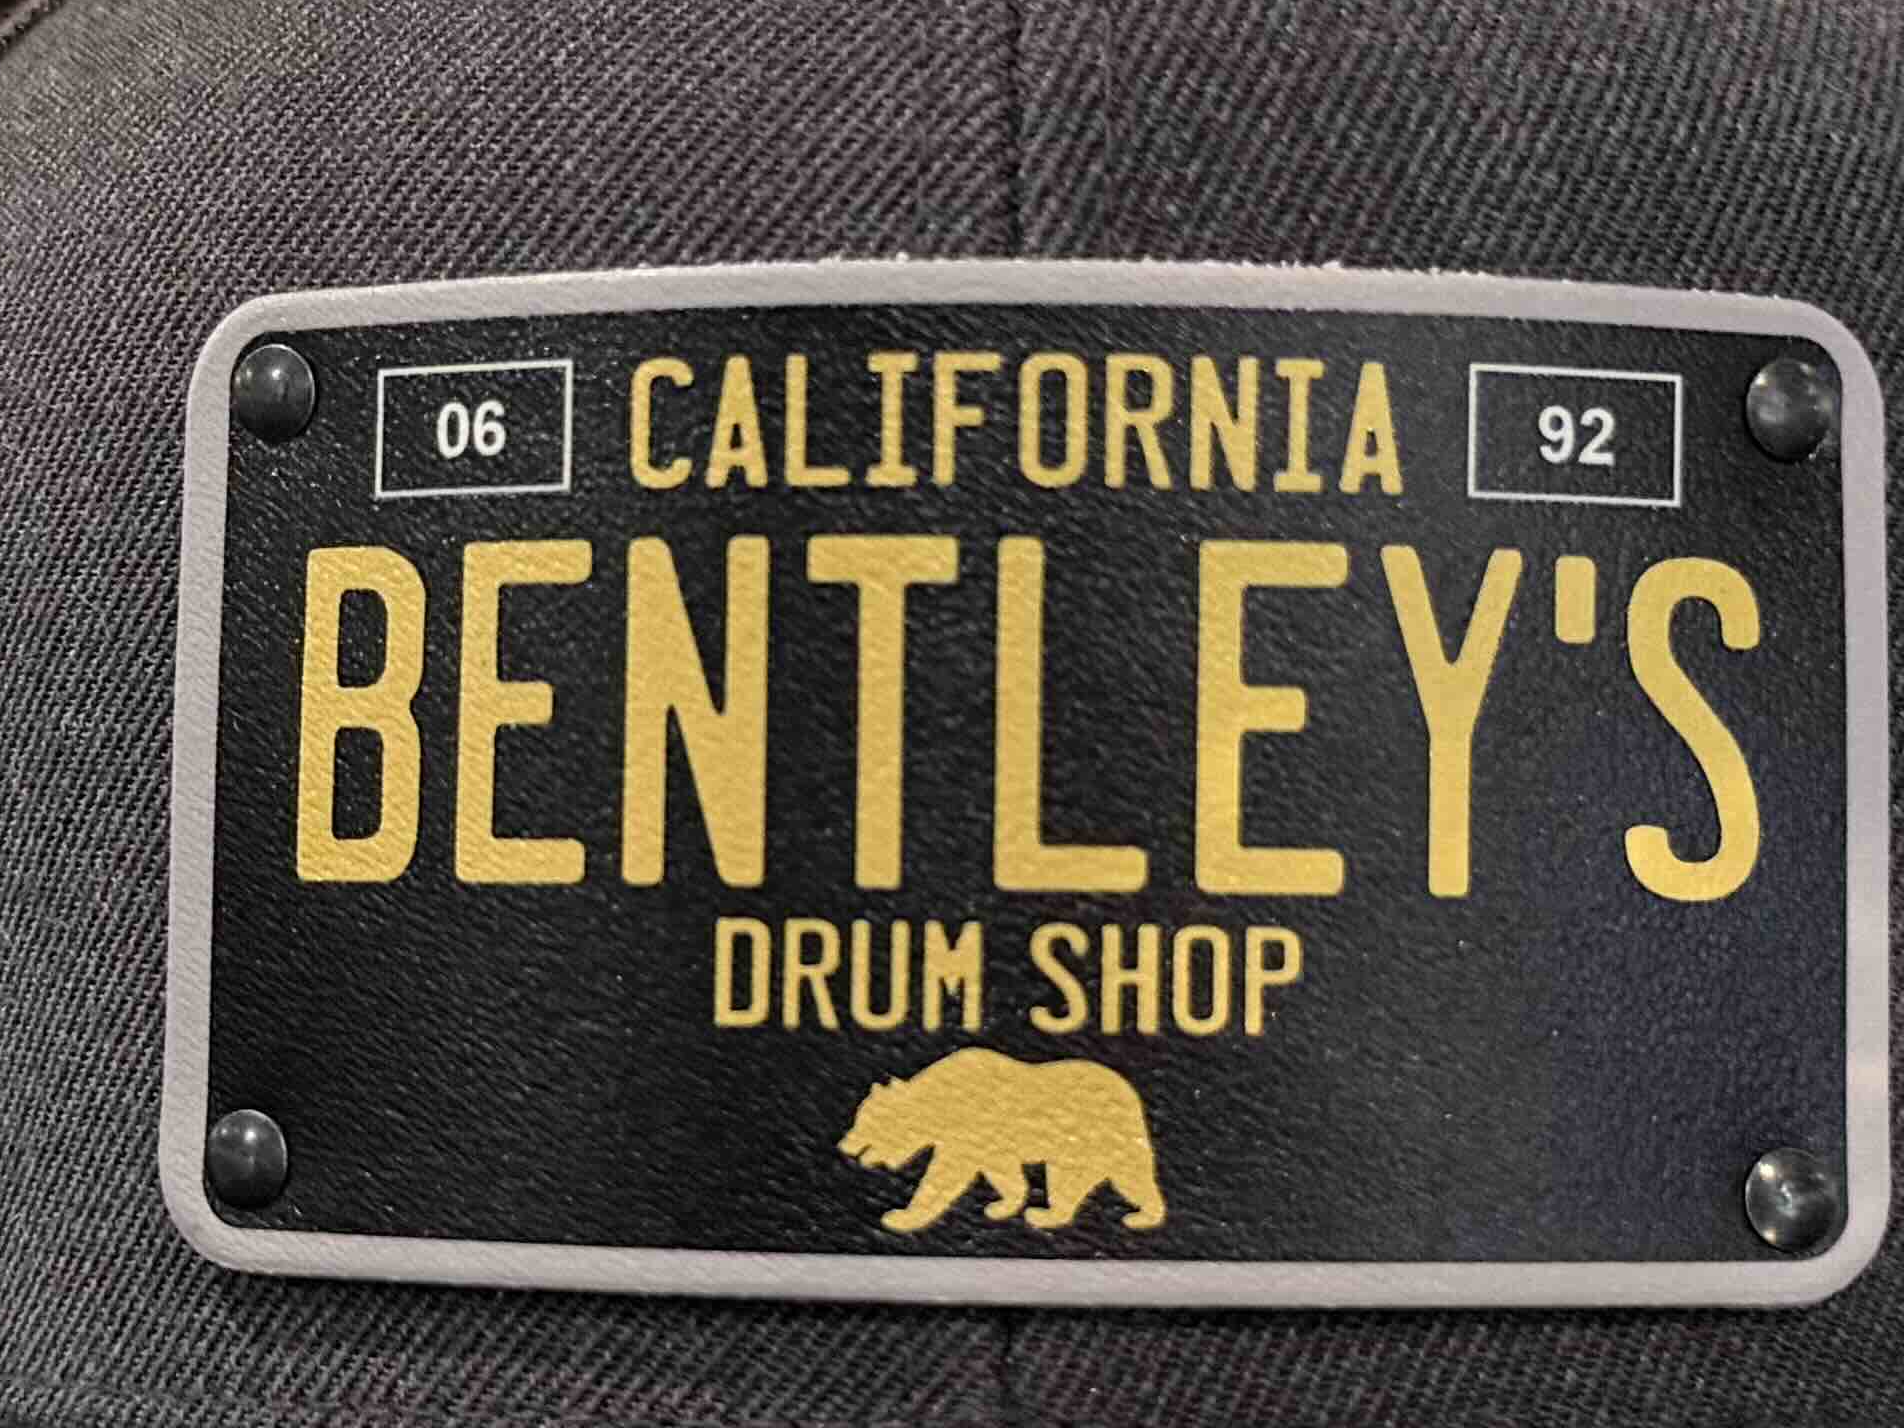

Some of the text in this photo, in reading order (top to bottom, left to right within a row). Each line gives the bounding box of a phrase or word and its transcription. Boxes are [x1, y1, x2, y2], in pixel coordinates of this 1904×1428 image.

[435, 398, 508, 460] 06
[628, 349, 1405, 497] CALIFORNIA
[1537, 404, 1617, 468] 92
[294, 533, 1762, 905] BENTLEY'S
[713, 915, 1305, 1038] DRUM SHOP
